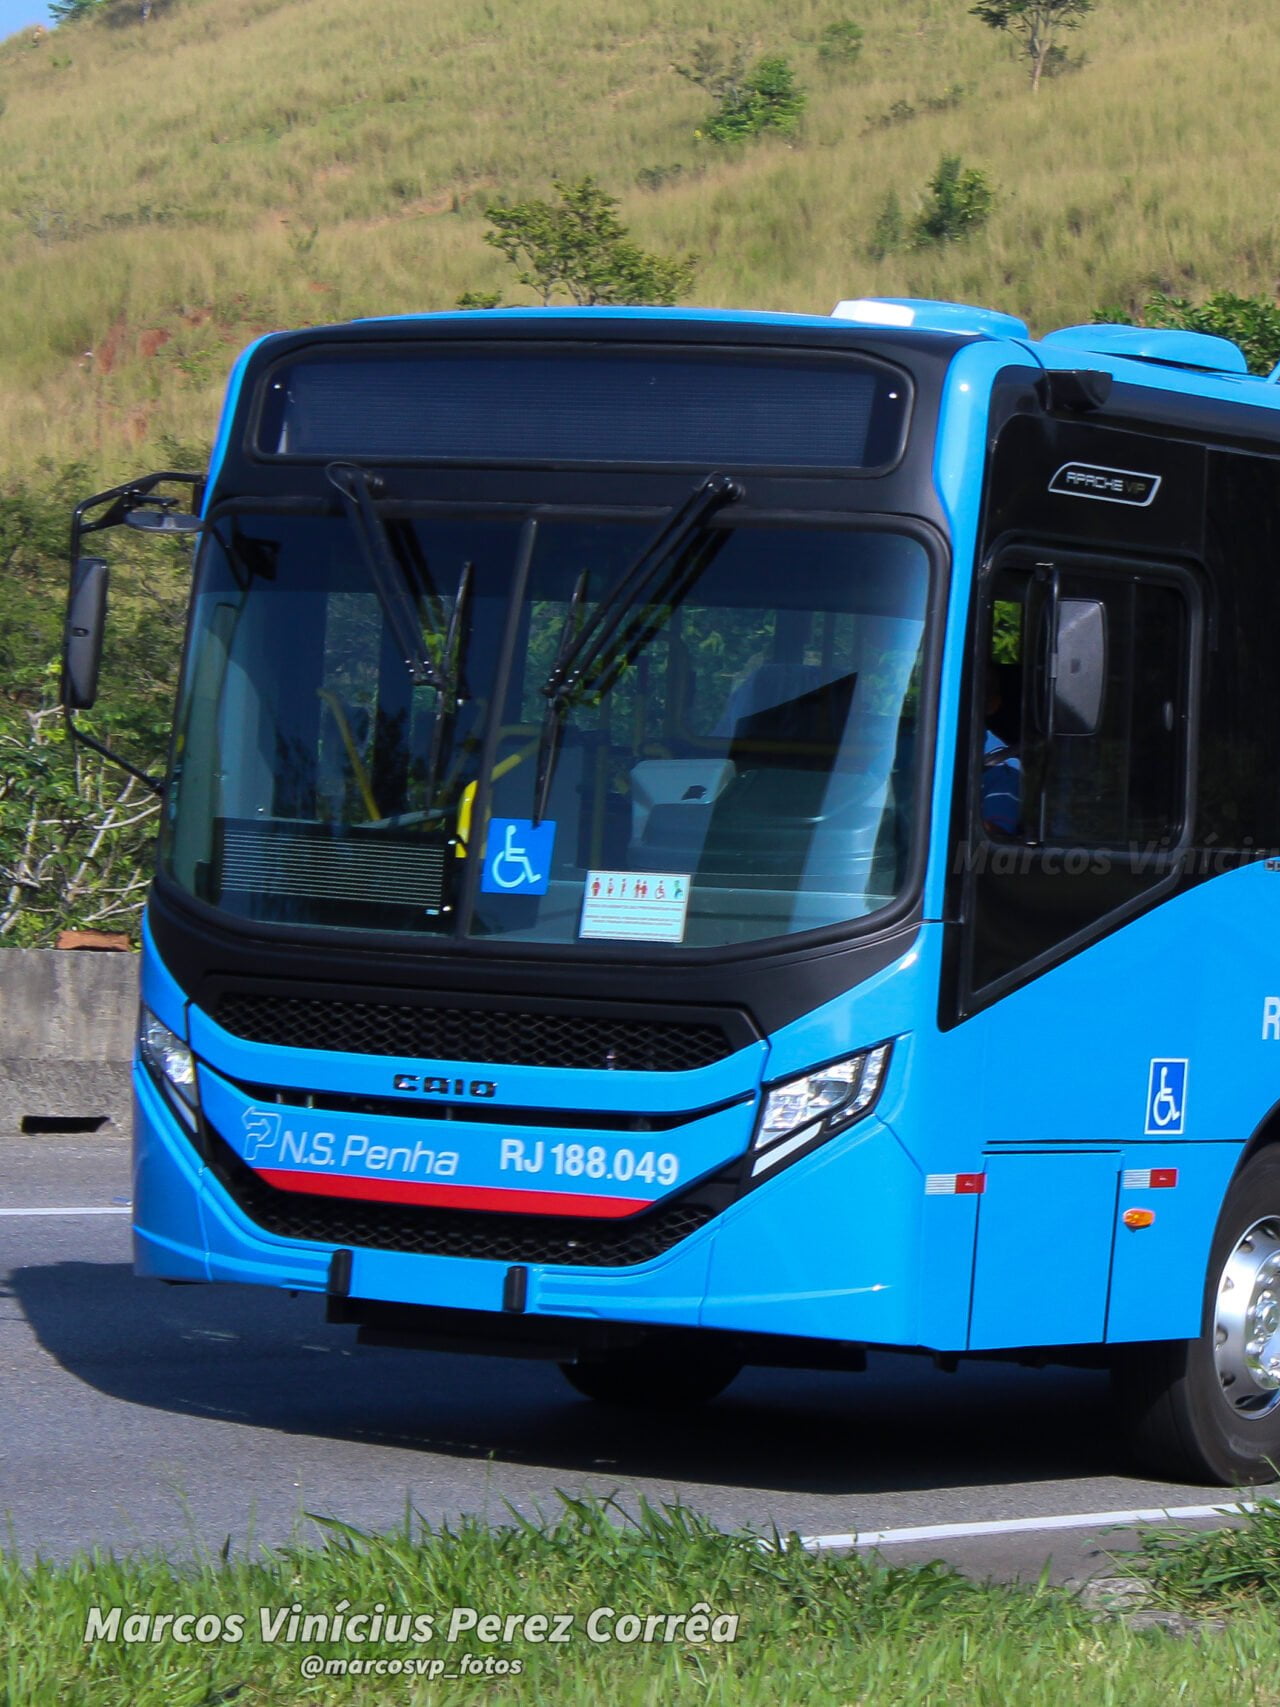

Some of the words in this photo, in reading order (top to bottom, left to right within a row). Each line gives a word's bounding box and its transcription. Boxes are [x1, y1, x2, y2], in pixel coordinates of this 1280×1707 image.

[1066, 471, 1123, 491] APACHE
[393, 1073, 498, 1098] CAIO
[279, 1131, 335, 1167] N.S.
[341, 1135, 459, 1177] Penha
[500, 1139, 544, 1174] RJ
[551, 1143, 679, 1186] 188.049
